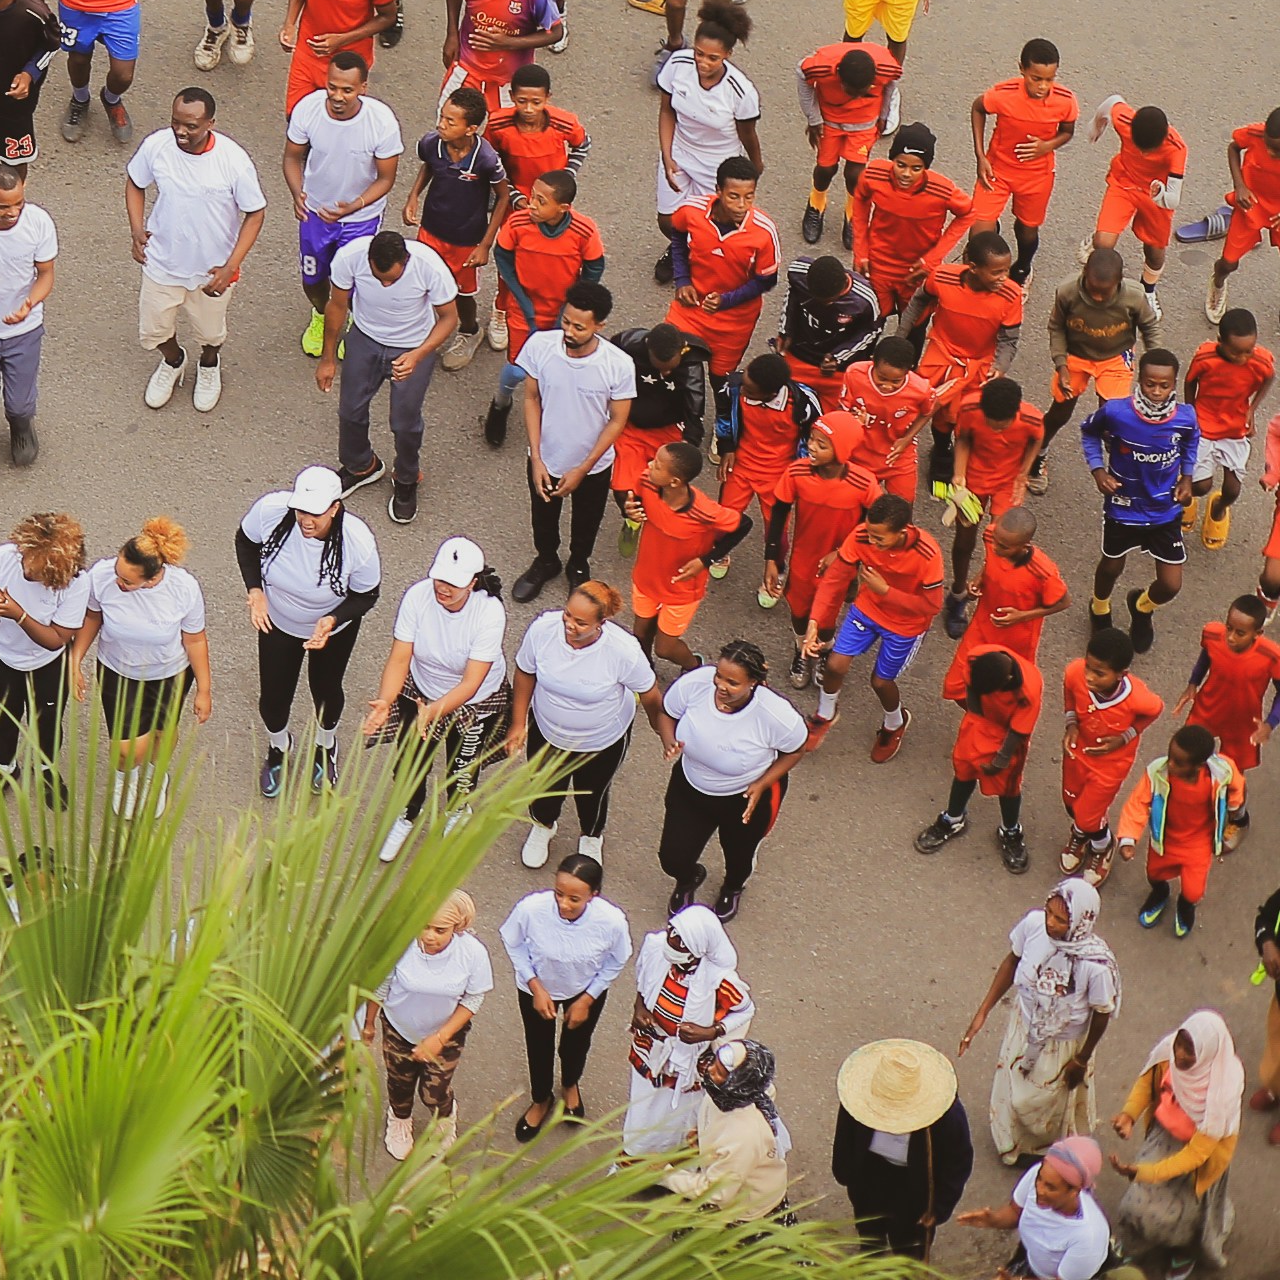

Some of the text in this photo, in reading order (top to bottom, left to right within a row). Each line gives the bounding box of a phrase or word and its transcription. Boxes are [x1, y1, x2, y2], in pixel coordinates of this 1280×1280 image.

[476, 11, 507, 27] Qatar
[5, 134, 34, 159] 23
[303, 255, 316, 276] 8
